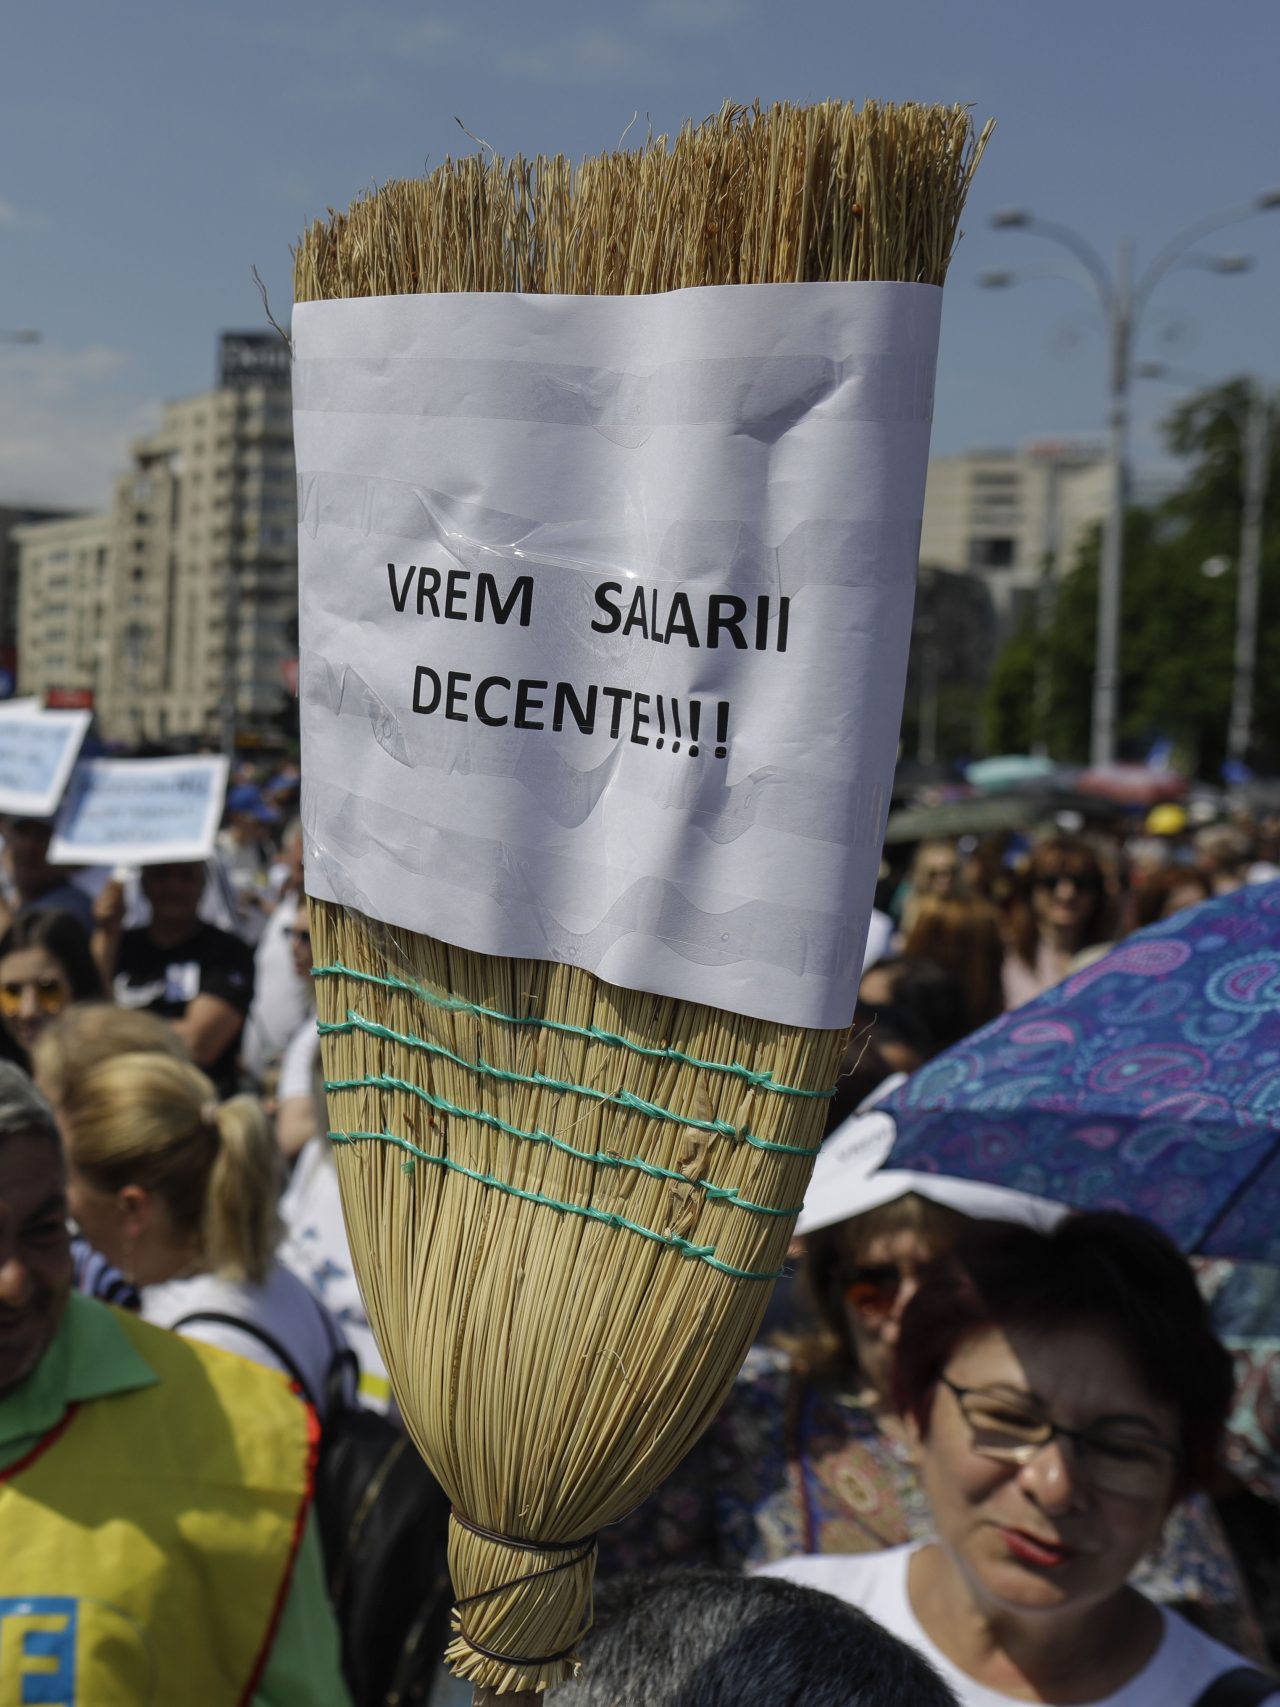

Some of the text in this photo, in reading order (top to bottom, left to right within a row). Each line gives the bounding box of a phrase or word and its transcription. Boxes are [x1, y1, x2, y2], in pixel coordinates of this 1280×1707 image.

[387, 562, 791, 653] VREM SALARII
[411, 665, 730, 760] DECENTE!!!!
